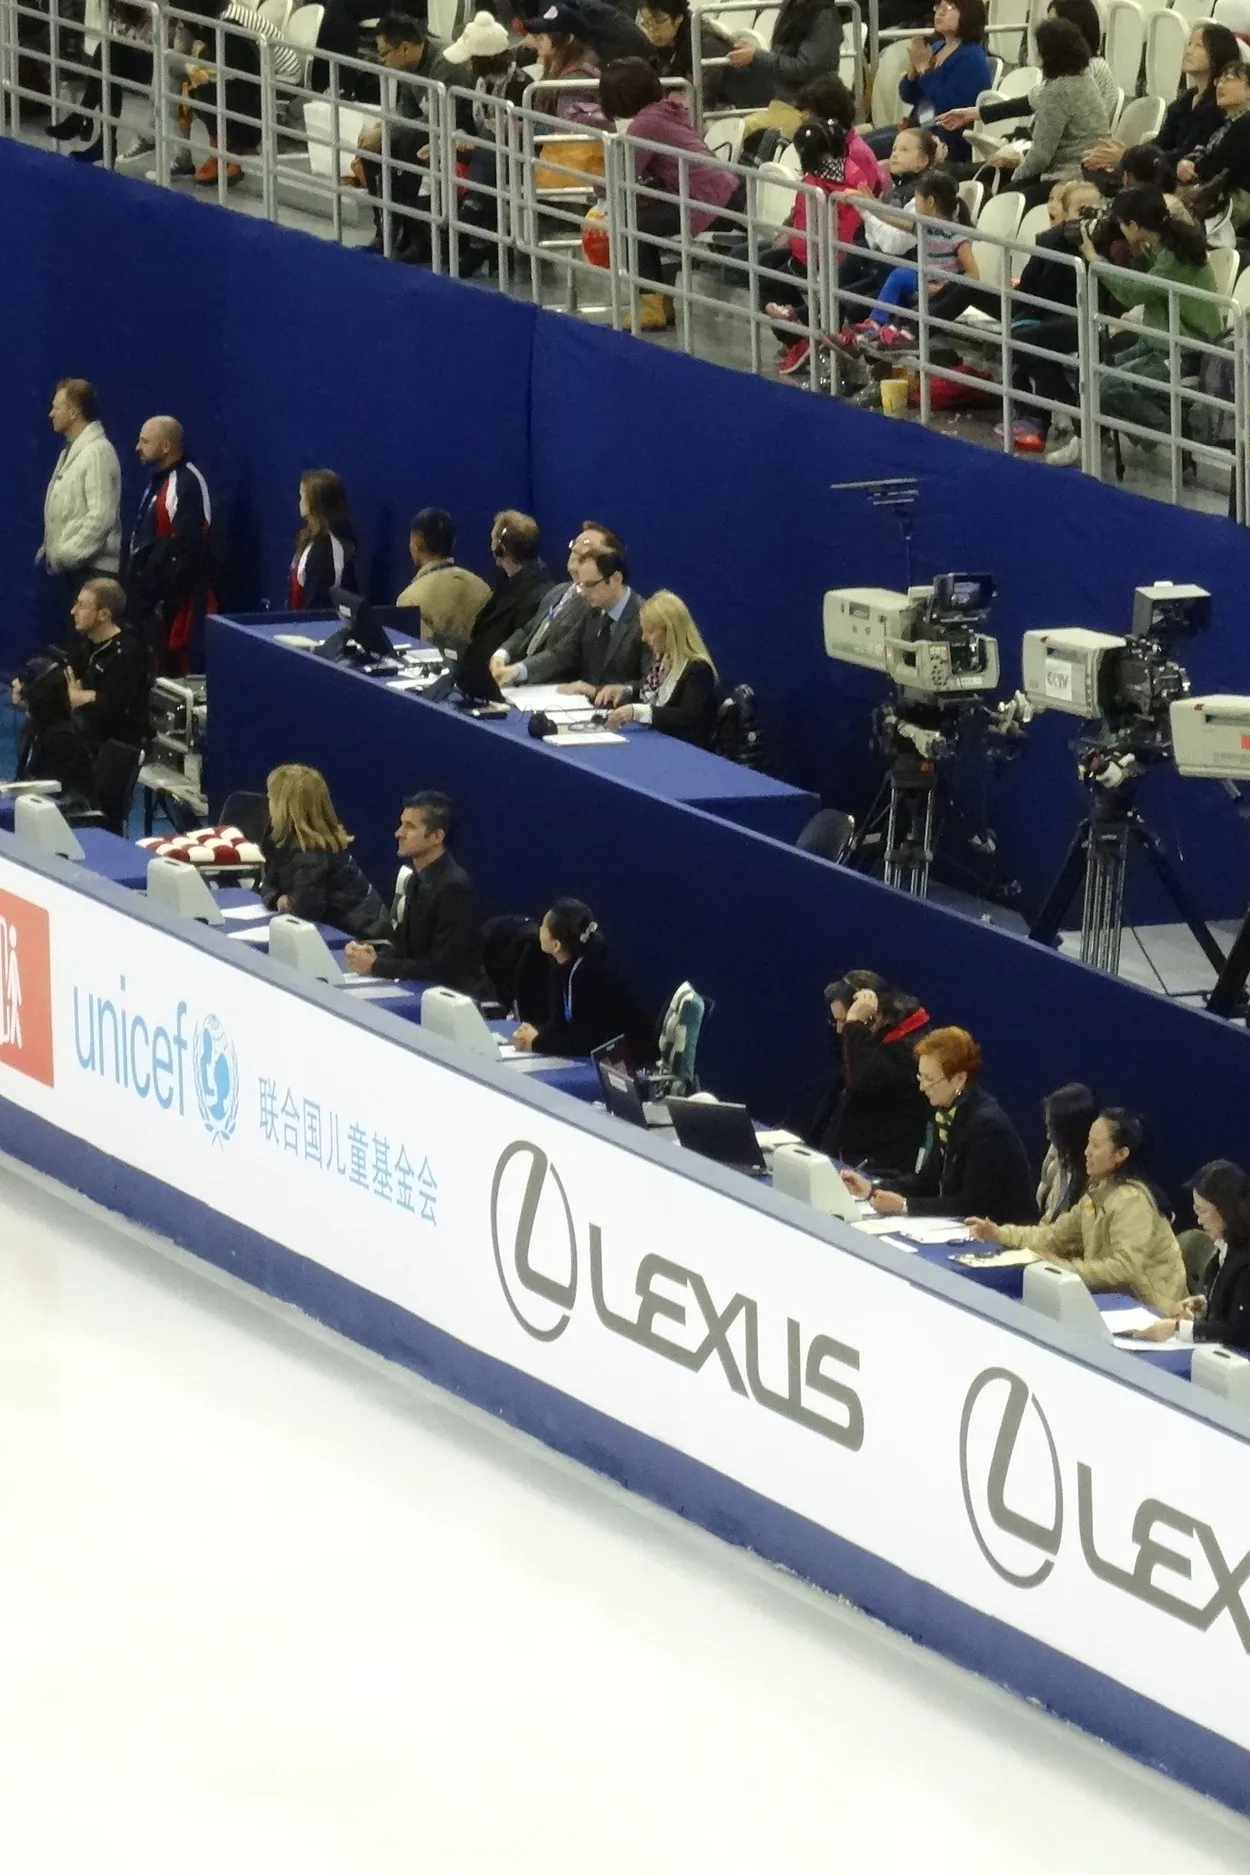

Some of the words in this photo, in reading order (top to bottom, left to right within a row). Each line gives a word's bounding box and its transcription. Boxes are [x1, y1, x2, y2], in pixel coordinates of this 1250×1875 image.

[74, 976, 187, 1116] unicef
[258, 1078, 437, 1226] 联合国儿童基金会
[589, 1223, 864, 1451] LEXUS
